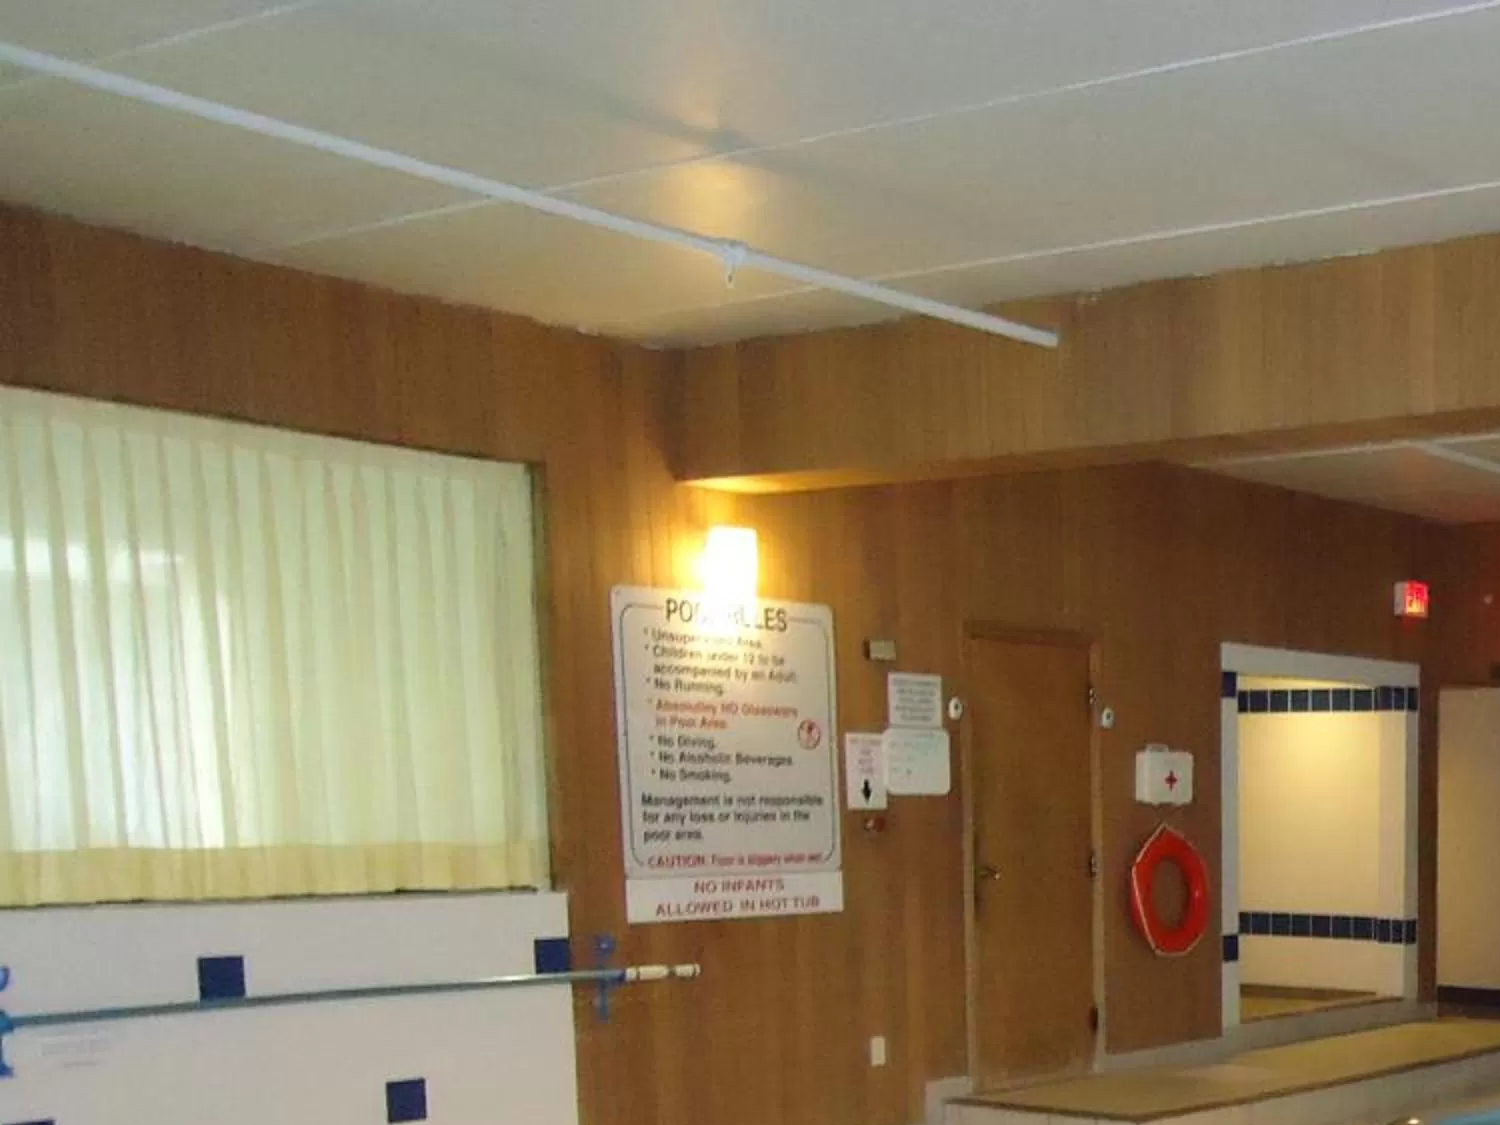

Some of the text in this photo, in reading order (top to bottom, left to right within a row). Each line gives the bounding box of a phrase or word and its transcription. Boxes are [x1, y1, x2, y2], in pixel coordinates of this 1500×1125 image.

[655, 677, 670, 690] No
[658, 735, 674, 747] No
[658, 752, 674, 764] No
[659, 768, 676, 781] No
[641, 792, 720, 809] Management
[663, 812, 685, 826] any
[694, 878, 785, 895] NO INFANTS
[655, 895, 821, 918] ALLOWED IN HOT TUB
